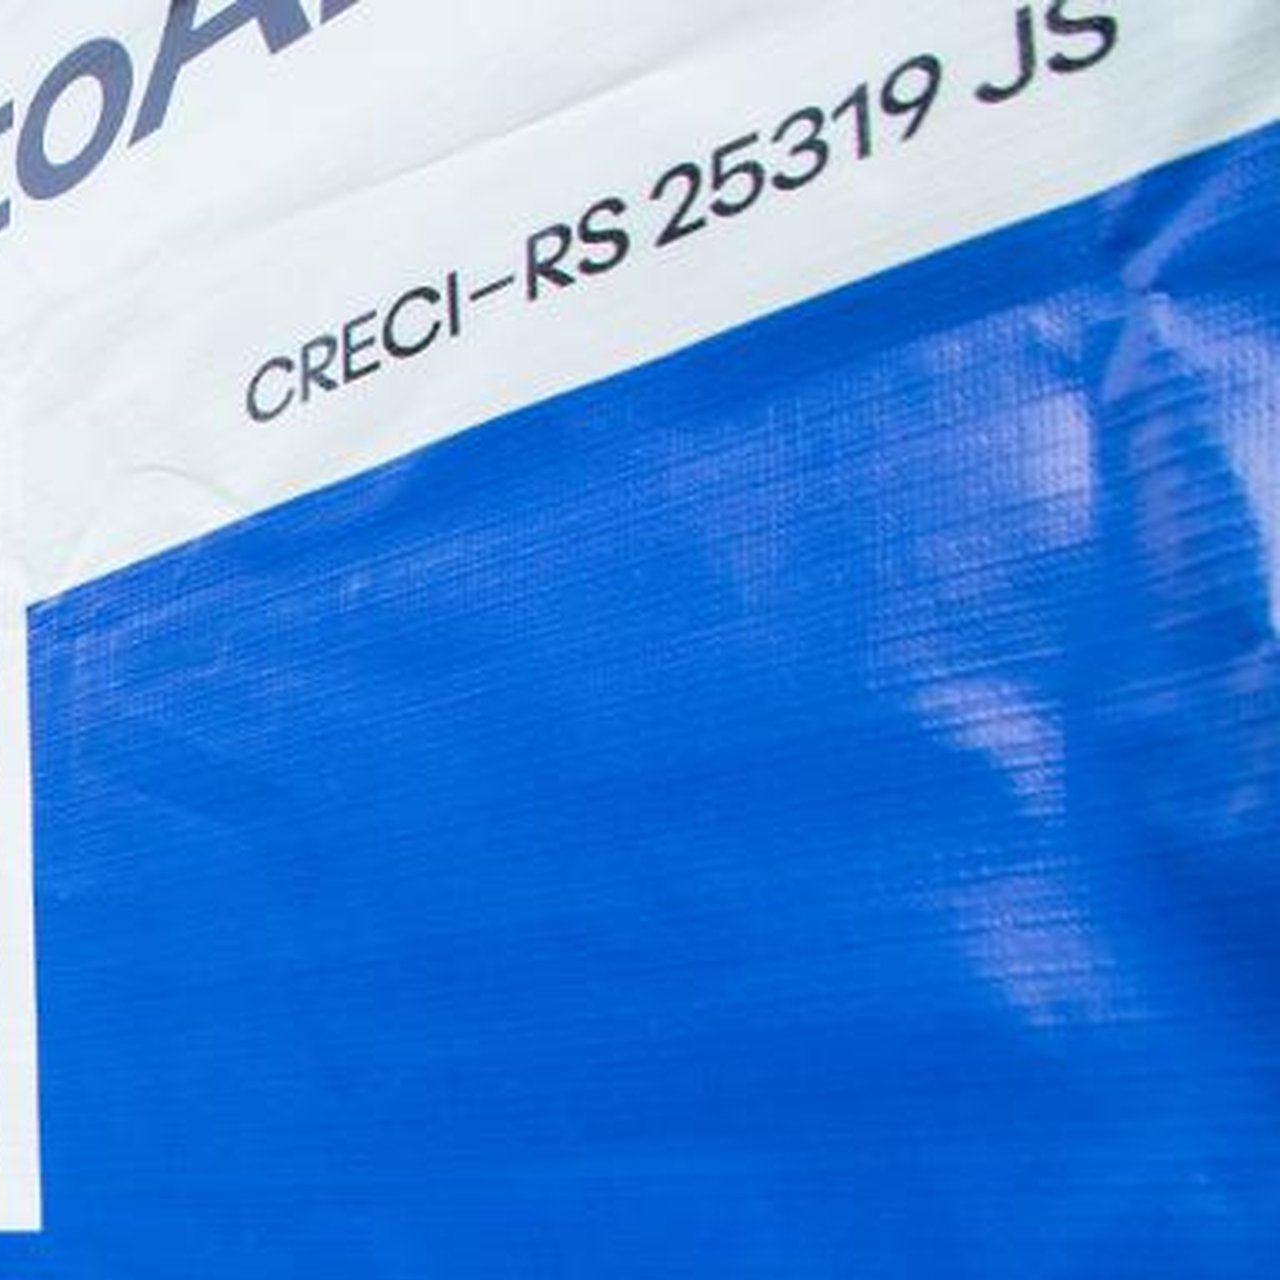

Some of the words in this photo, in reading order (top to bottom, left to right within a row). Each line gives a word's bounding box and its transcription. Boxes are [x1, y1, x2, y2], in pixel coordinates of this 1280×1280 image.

[244, 195, 633, 425] CRECI-RS
[648, 52, 944, 249] 25319
[972, 0, 1120, 104] JS
